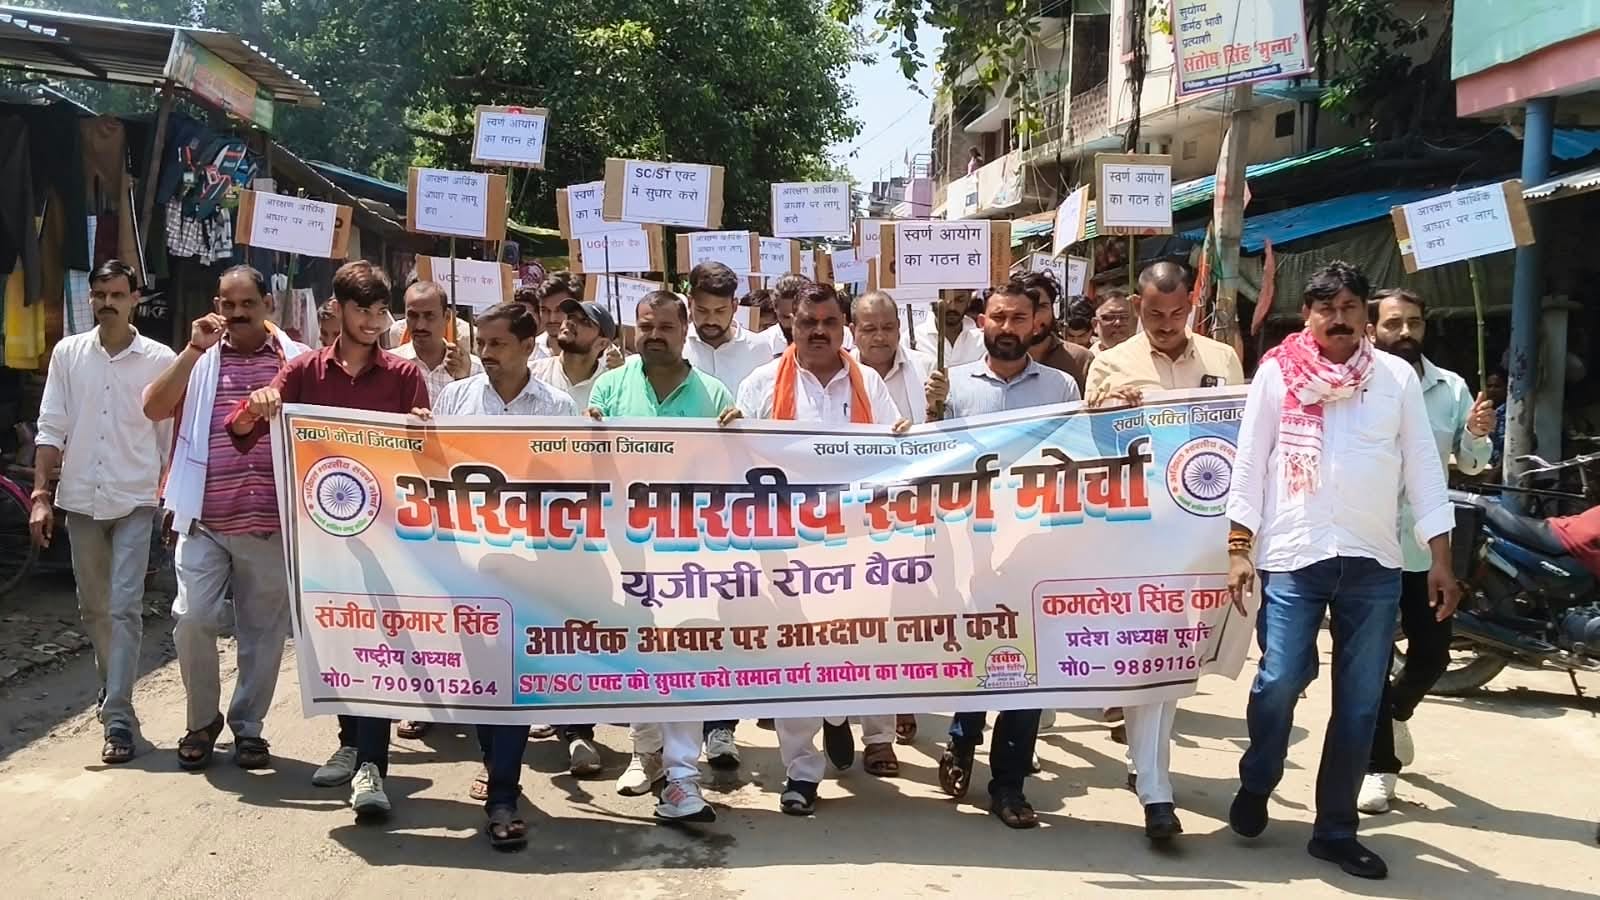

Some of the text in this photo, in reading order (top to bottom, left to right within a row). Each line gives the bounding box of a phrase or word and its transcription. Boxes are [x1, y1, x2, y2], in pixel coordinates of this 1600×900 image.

[1180, 13, 1223, 32] कर्मठ भावी
[1182, 31, 1212, 48] प्रत्याशी
[1183, 51, 1219, 72] संतोष
[1223, 43, 1250, 65] सिंह
[484, 135, 496, 144] का
[527, 135, 536, 147] हो
[635, 167, 697, 182] SC/ST एक्ट
[1109, 168, 1164, 184] स्वर्ण आयोग
[574, 186, 595, 200] स्वर्ण
[631, 184, 640, 197] में
[678, 188, 698, 201] करो
[1109, 192, 1164, 207] का गठन हो
[809, 200, 819, 208] पर
[1417, 191, 1491, 216] आरक्षण आर्थिक
[292, 217, 303, 225] पर
[576, 209, 588, 219] का
[1456, 213, 1470, 224] पर
[1474, 208, 1499, 221] लागू
[865, 233, 881, 241] UG
[904, 224, 982, 241] स्वर्ण आयोग
[1426, 237, 1445, 249] करो
[904, 248, 982, 266] का गठन हो
[1113, 412, 1144, 432] सवर्ण
[1148, 409, 1187, 426] शक्ति
[296, 426, 330, 441] सवर्ण
[367, 430, 424, 452] जिंदाबाद
[530, 436, 674, 455] सवर्ण एकता जिंदाबाद
[813, 441, 849, 456] सवर्ण
[853, 442, 897, 456] समाज
[396, 437, 1152, 542] अखिल भारतीय स्वर्ण मोर्चा
[620, 552, 936, 608] यूजीसी रोल बैक
[1042, 587, 1132, 616] कमलेश
[1137, 583, 1185, 613] सिंह
[314, 600, 501, 638] संजीव कुमार सिंह
[526, 618, 629, 655] आर्थिक
[730, 625, 769, 650] पर
[777, 616, 889, 648] आरक्षण
[894, 612, 963, 653] लागू
[962, 603, 1020, 641] करो
[1065, 626, 1109, 648] प्रदेश
[1115, 629, 1168, 647] अध्यक्ष
[352, 644, 462, 669] राष्ट्रीय अध्यक्ष
[371, 674, 499, 696] 7909015264
[519, 673, 583, 695] ST/SC
[586, 673, 623, 691] एक्ट
[625, 667, 650, 690] को
[698, 665, 732, 688] करो
[734, 667, 781, 687] समान
[785, 661, 811, 684] वर्ग
[816, 660, 871, 683] आयोग
[874, 664, 898, 681] का
[901, 662, 939, 680] गठन
[941, 657, 975, 678] करो
